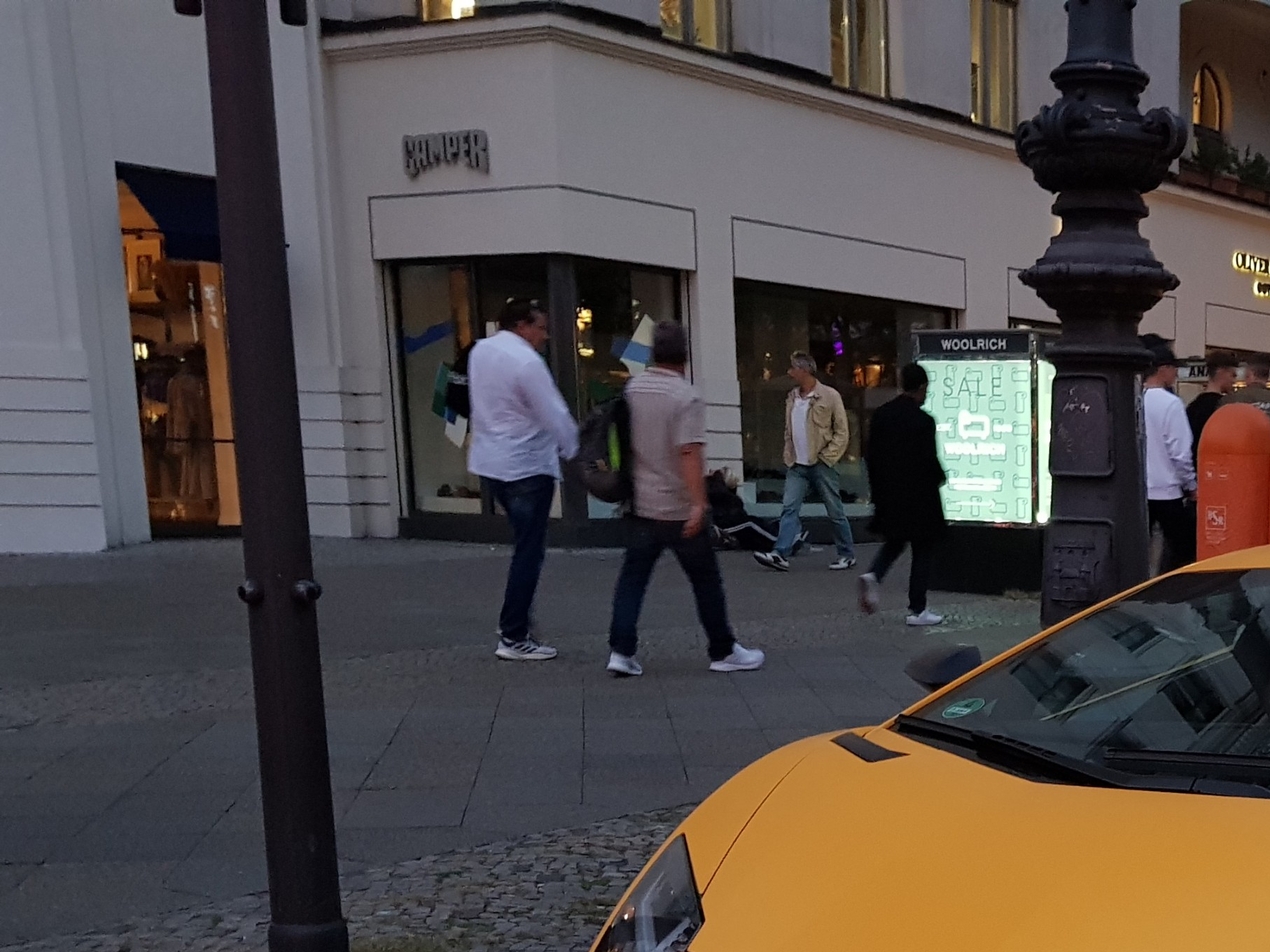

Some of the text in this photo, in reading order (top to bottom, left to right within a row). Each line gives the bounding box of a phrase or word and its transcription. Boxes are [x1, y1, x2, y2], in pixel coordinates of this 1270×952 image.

[402, 129, 490, 178] CAMPER
[1233, 252, 1270, 277] OLIVER
[941, 338, 1007, 351] WOOLRICH
[943, 376, 1003, 397] SALE
